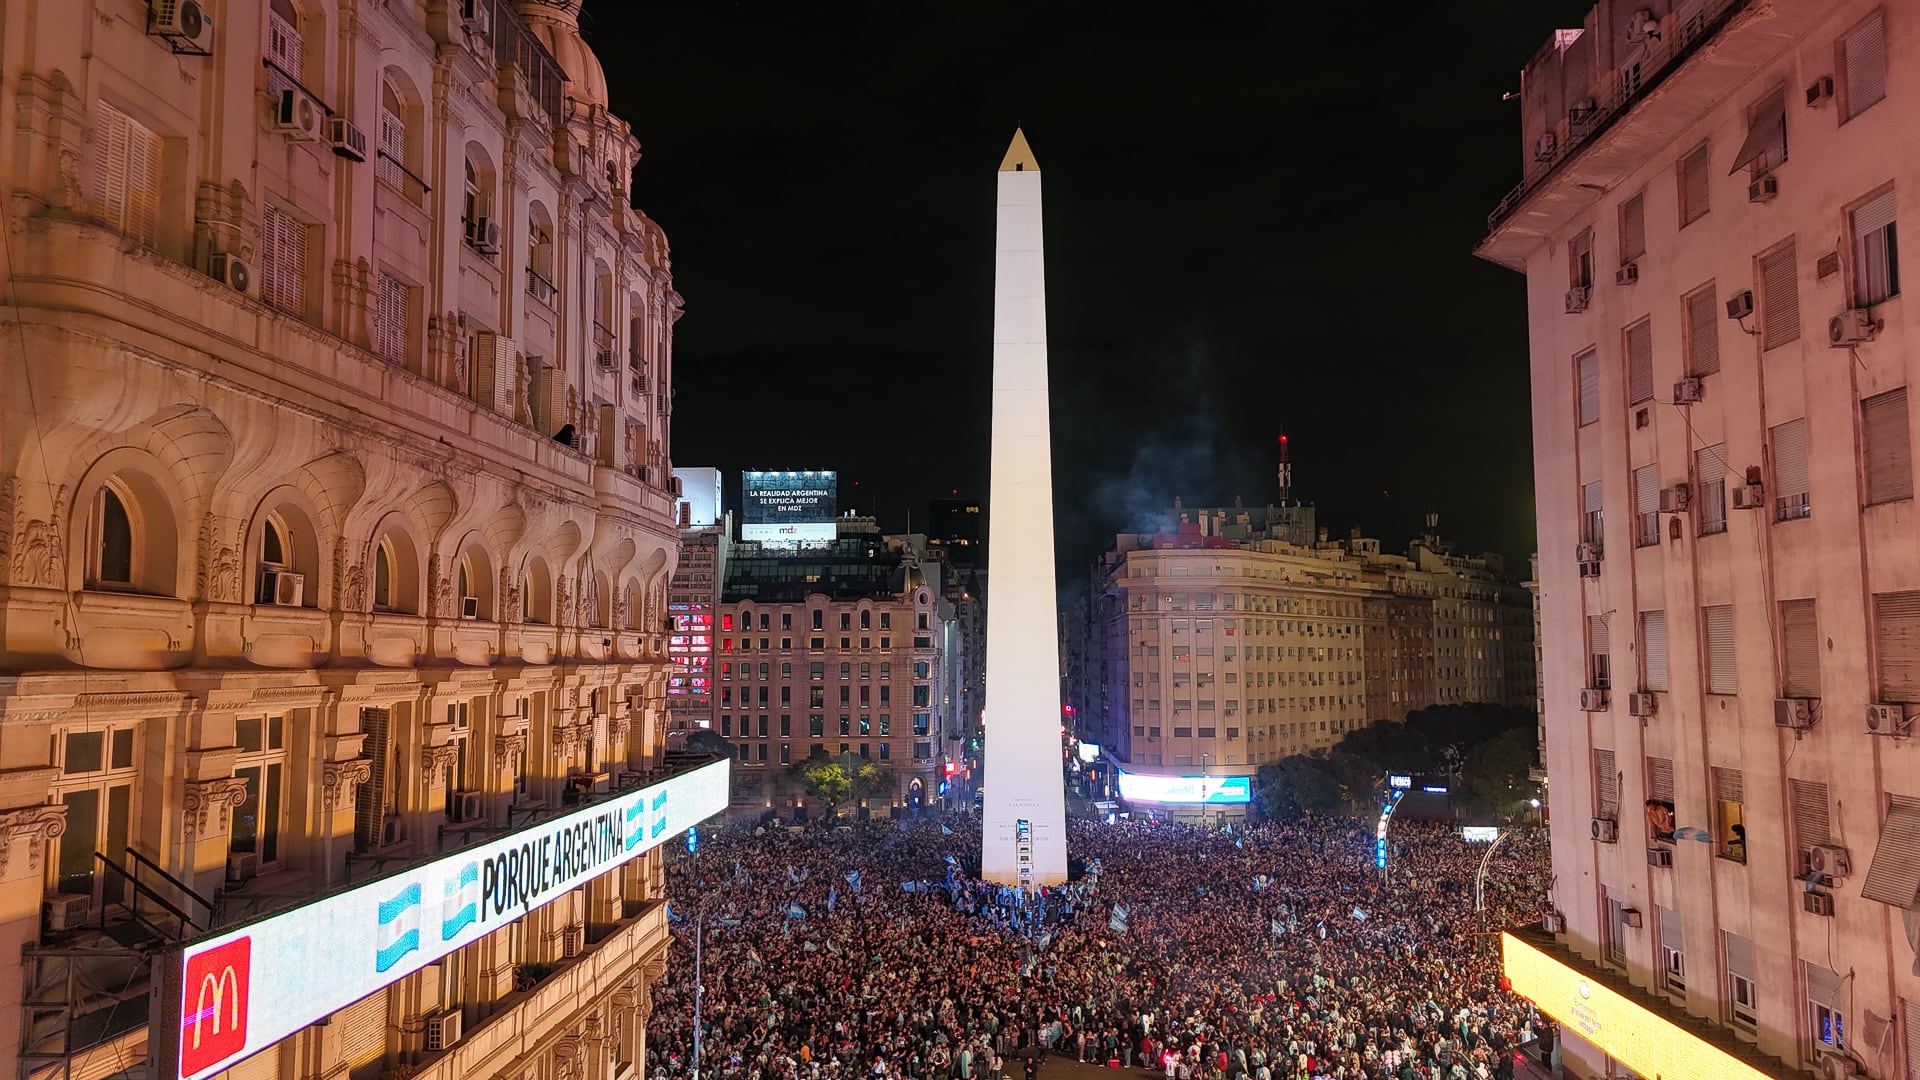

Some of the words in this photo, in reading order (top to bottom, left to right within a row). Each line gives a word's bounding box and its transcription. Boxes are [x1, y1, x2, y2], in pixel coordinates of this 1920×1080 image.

[779, 525, 798, 534] mdz
[481, 833, 551, 923] PORQUE
[551, 808, 623, 888] ARGENTINA
